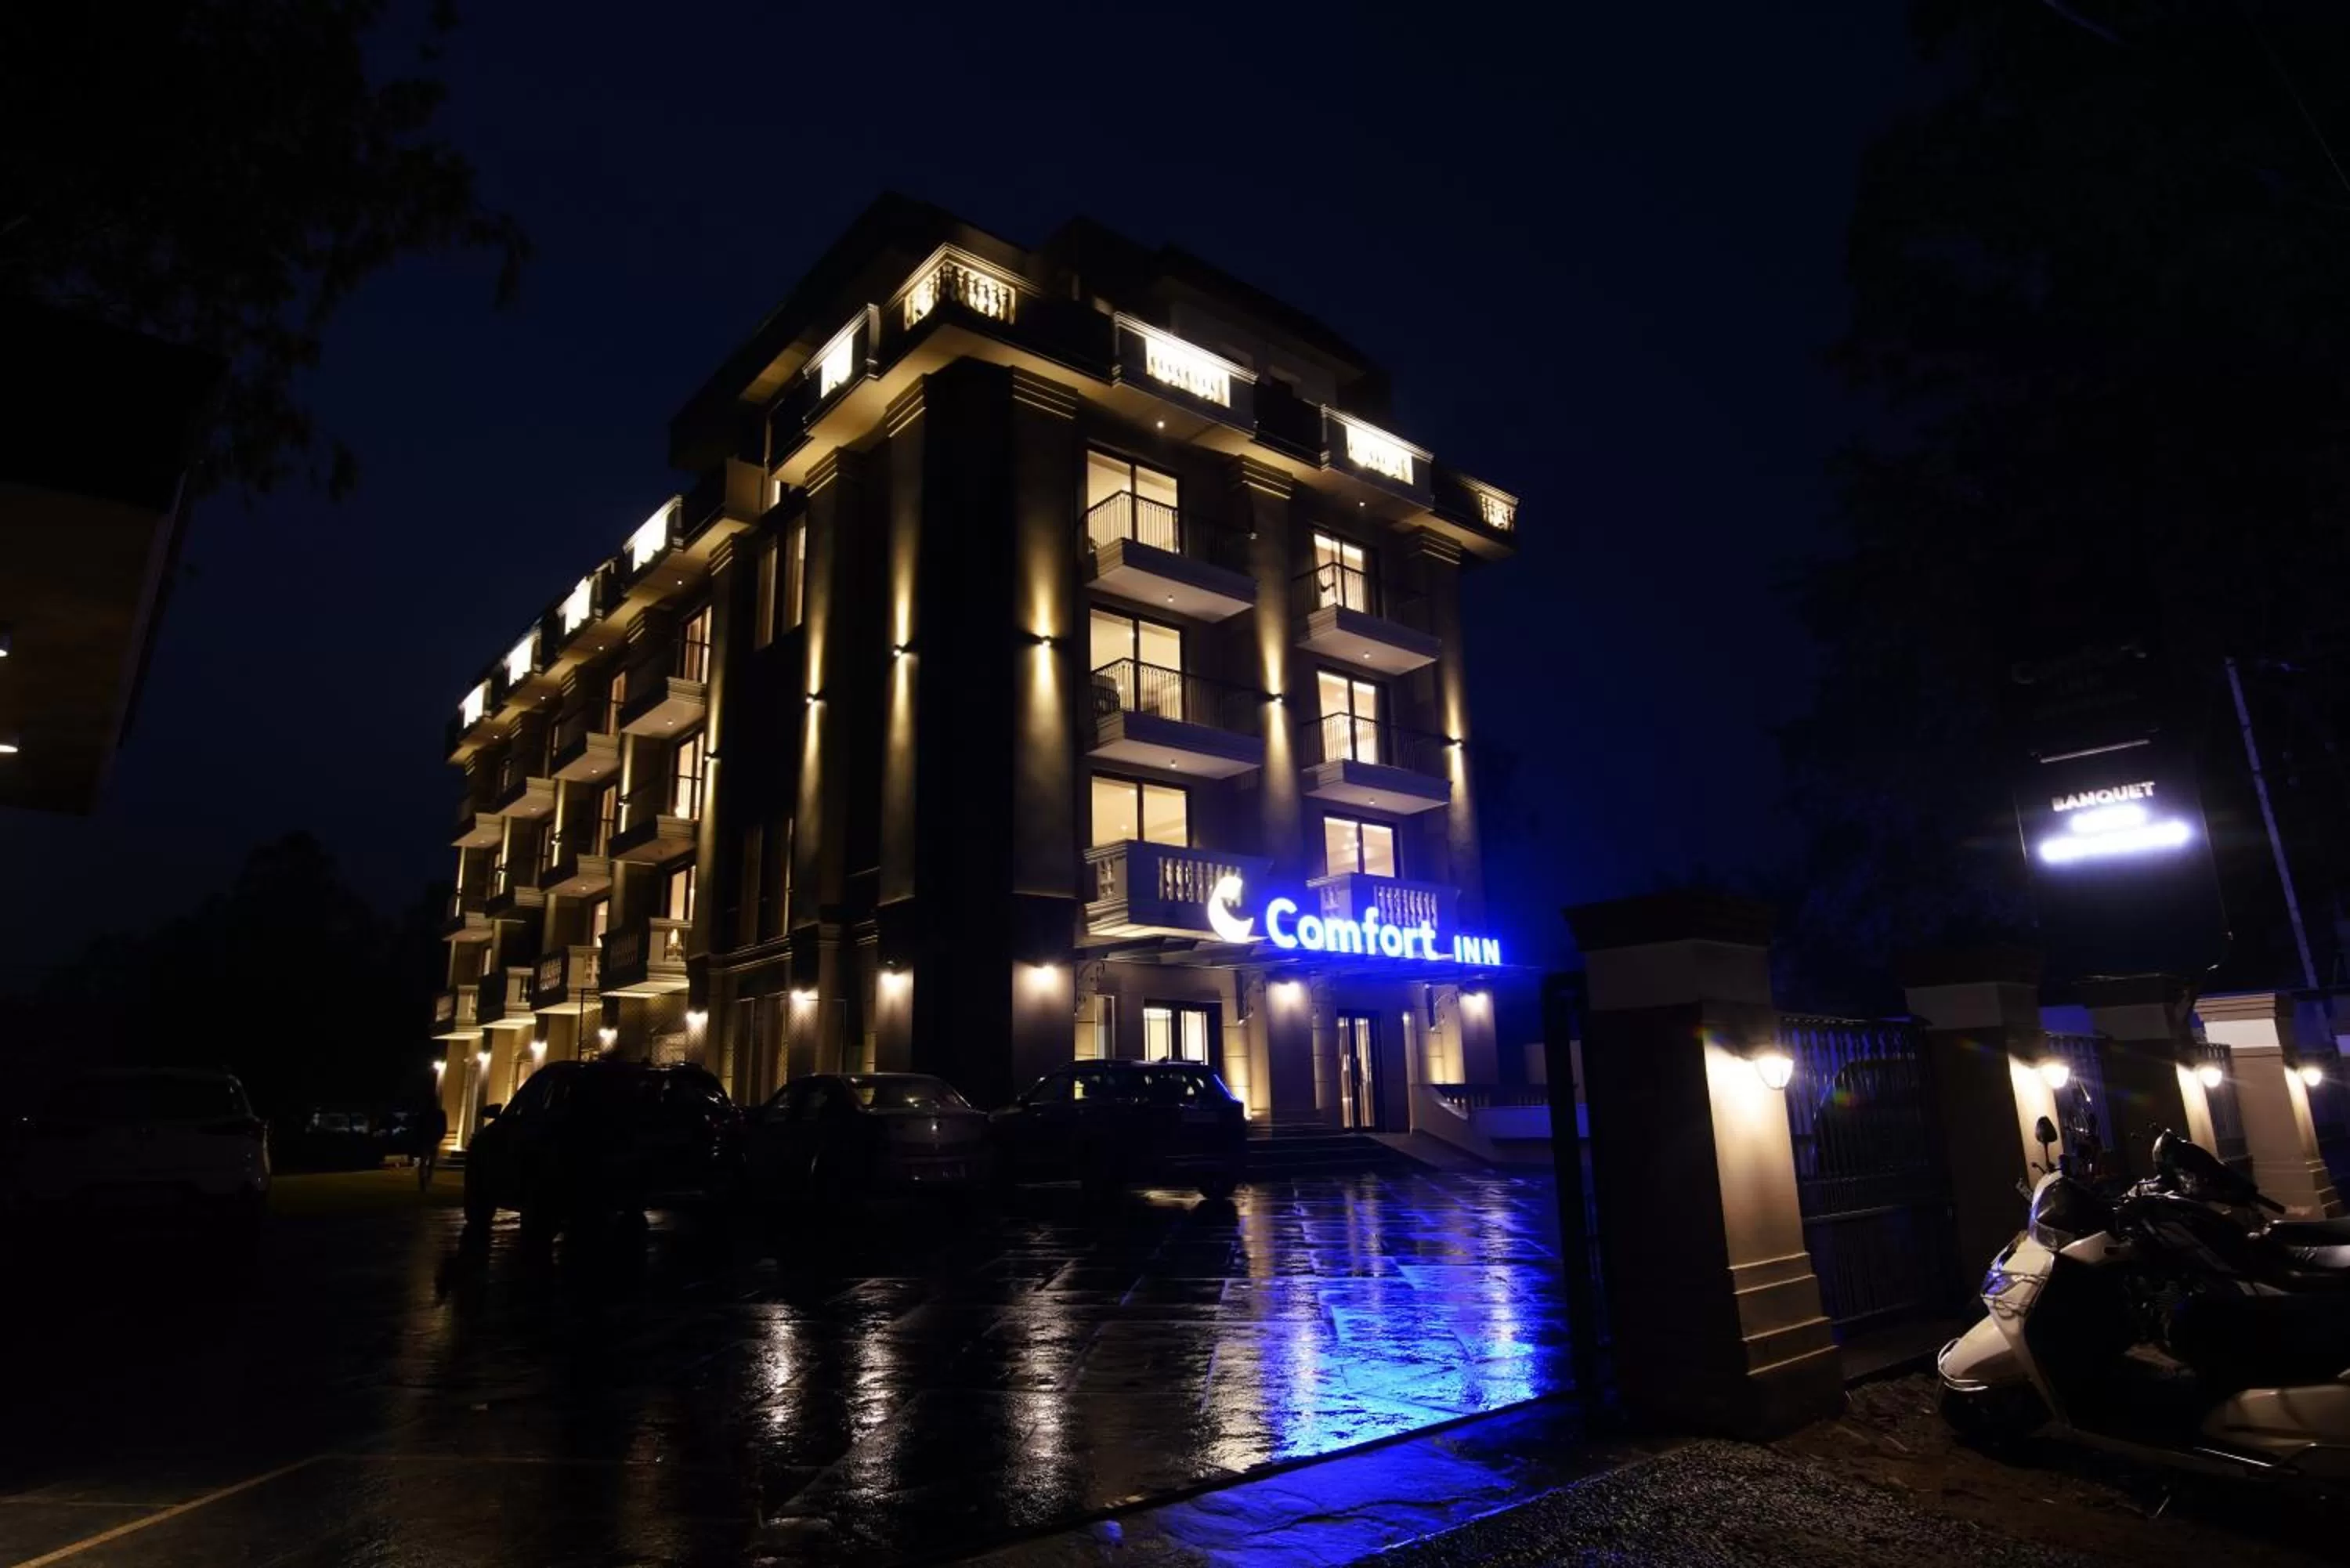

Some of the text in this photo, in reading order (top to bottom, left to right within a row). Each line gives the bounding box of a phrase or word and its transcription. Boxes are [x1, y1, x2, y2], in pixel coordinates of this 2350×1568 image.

[2052, 781, 2155, 811] BANQUET
[1267, 898, 1500, 965] Comfort INN
